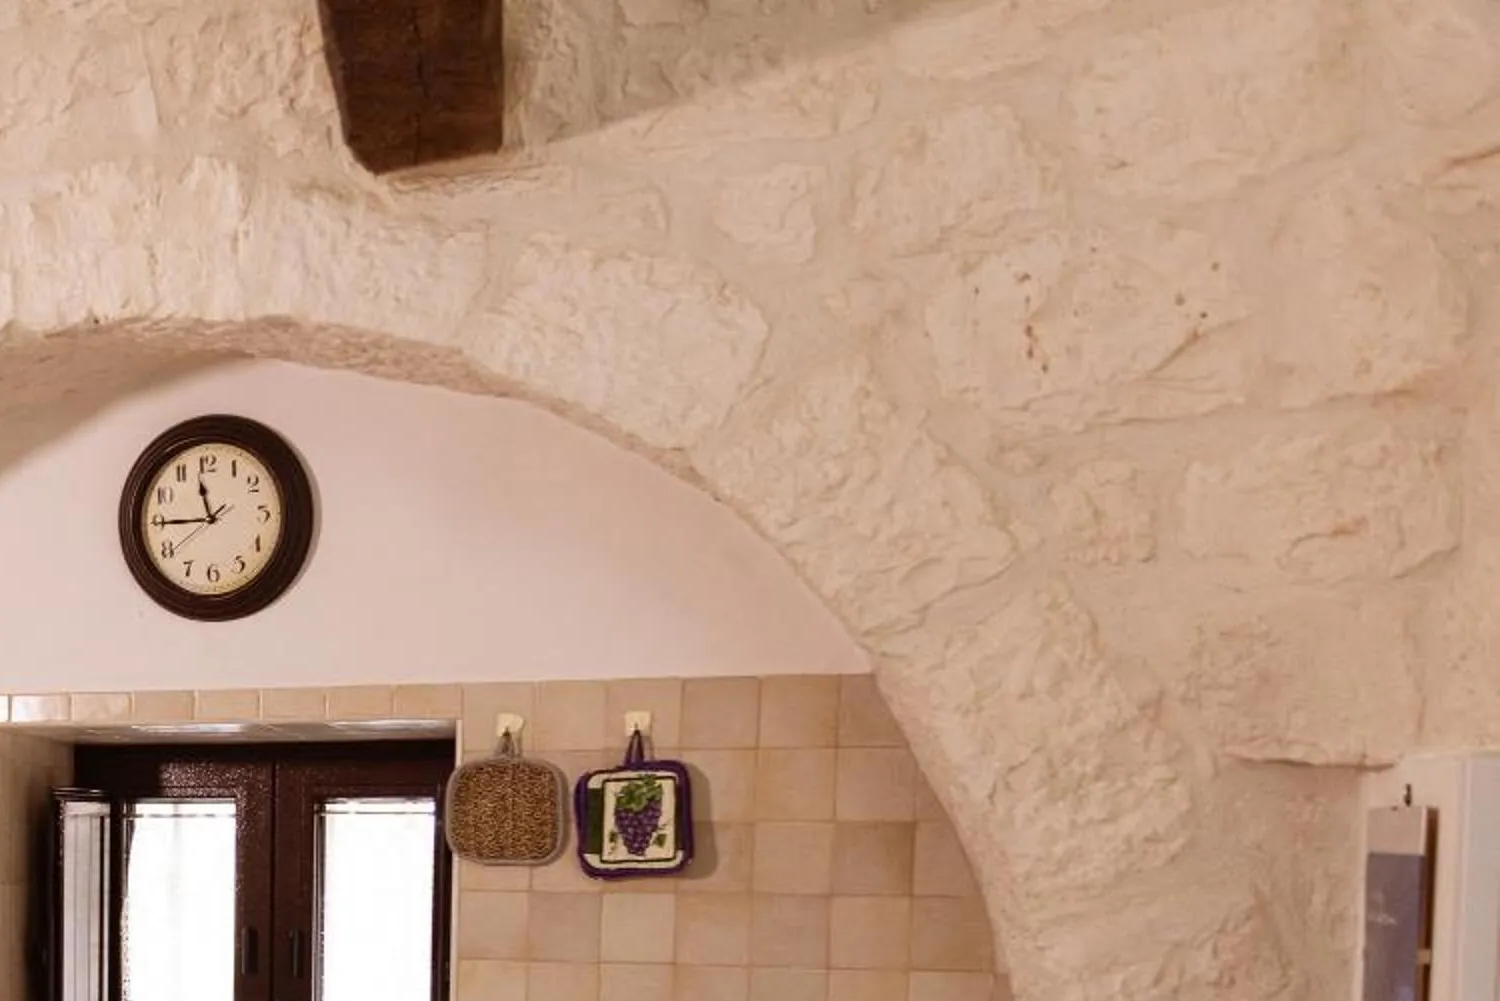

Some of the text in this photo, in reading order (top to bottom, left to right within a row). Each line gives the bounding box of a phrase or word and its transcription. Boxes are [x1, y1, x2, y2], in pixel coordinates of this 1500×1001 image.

[176, 463, 187, 483] 11
[199, 454, 217, 474] 12
[232, 459, 237, 477] 1
[246, 474, 260, 494] 2
[157, 485, 173, 505] 10
[152, 513, 165, 530] 9
[160, 539, 175, 559] 8
[183, 559, 194, 577] 7
[206, 563, 221, 583] 6
[232, 555, 246, 574] 5
